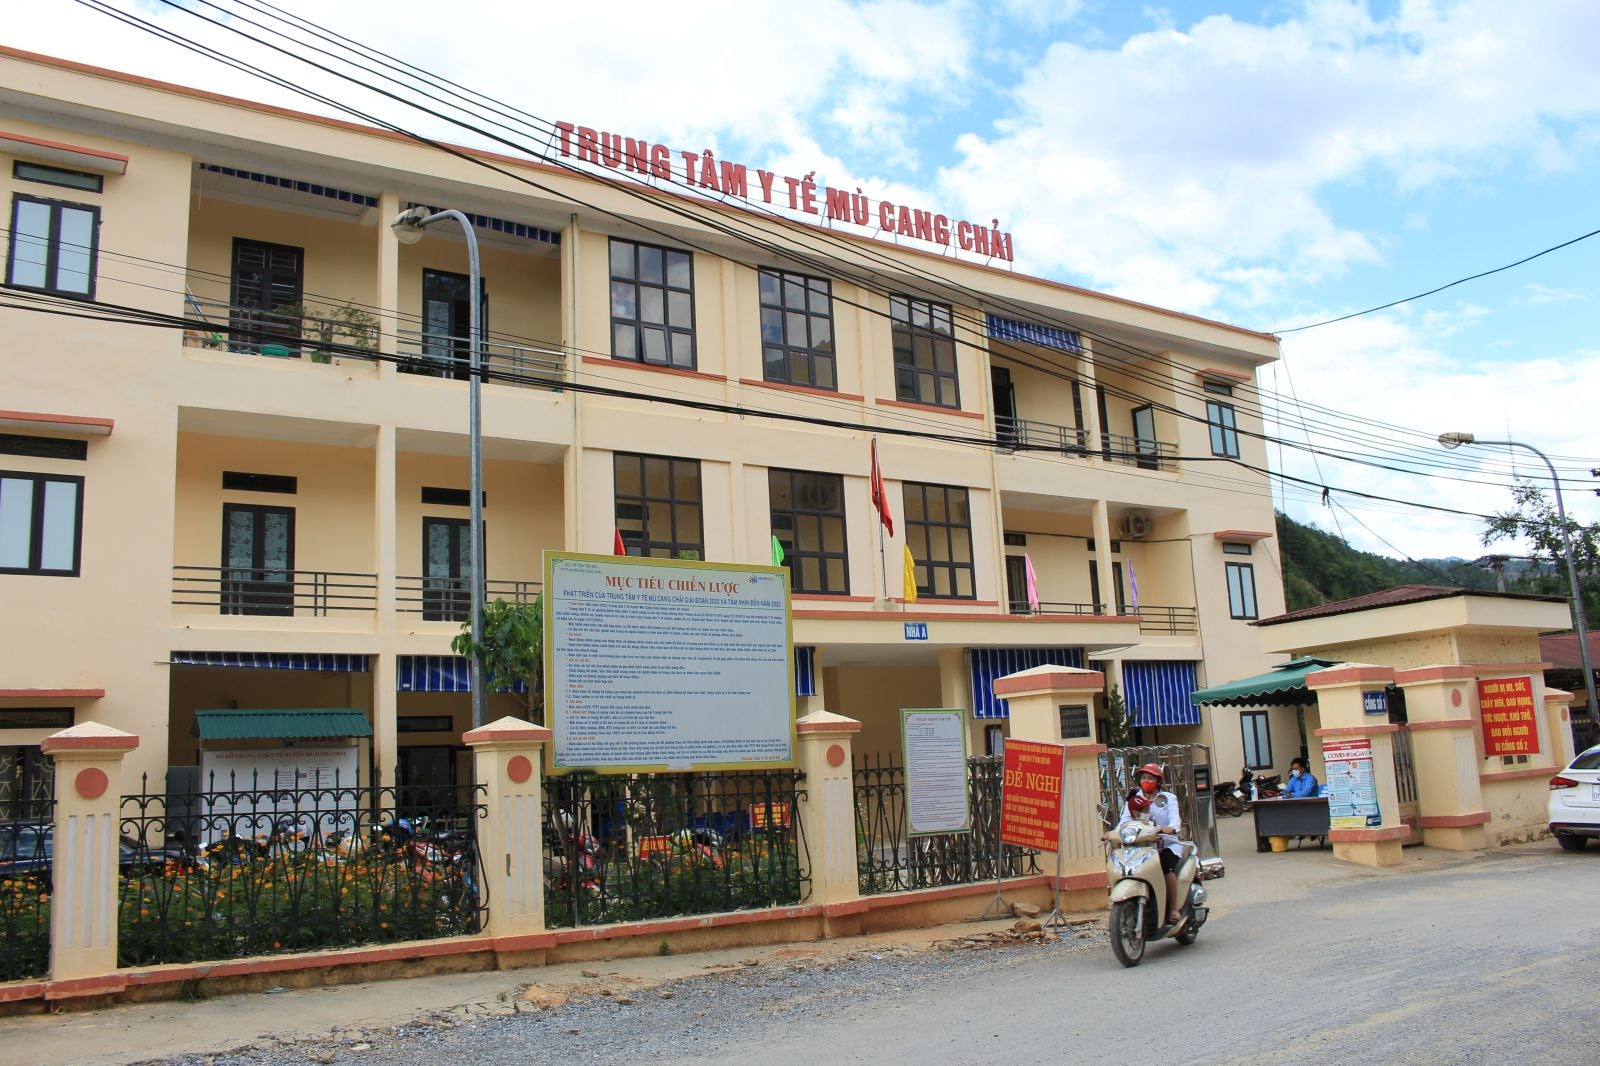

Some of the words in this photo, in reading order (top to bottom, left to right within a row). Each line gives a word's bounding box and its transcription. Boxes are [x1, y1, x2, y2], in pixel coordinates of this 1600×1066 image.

[555, 120, 671, 180] TRUNG
[681, 149, 747, 198] TÂM
[756, 169, 775, 203] Y
[784, 171, 819, 214] TẾ
[826, 187, 869, 226] MÙ
[879, 201, 949, 245] CANG
[958, 218, 1014, 262] CHẢI
[605, 575, 633, 591] MỤC
[636, 576, 665, 590] TIÊU
[668, 576, 706, 592] CHIẾN
[709, 581, 740, 597] LƯỢC
[906, 624, 920, 638] NHÀ
[921, 626, 927, 638] A
[1524, 742, 1528, 750] 2
[1004, 762, 1022, 788] ĐỀ
[1025, 772, 1060, 798] NGHỊ
